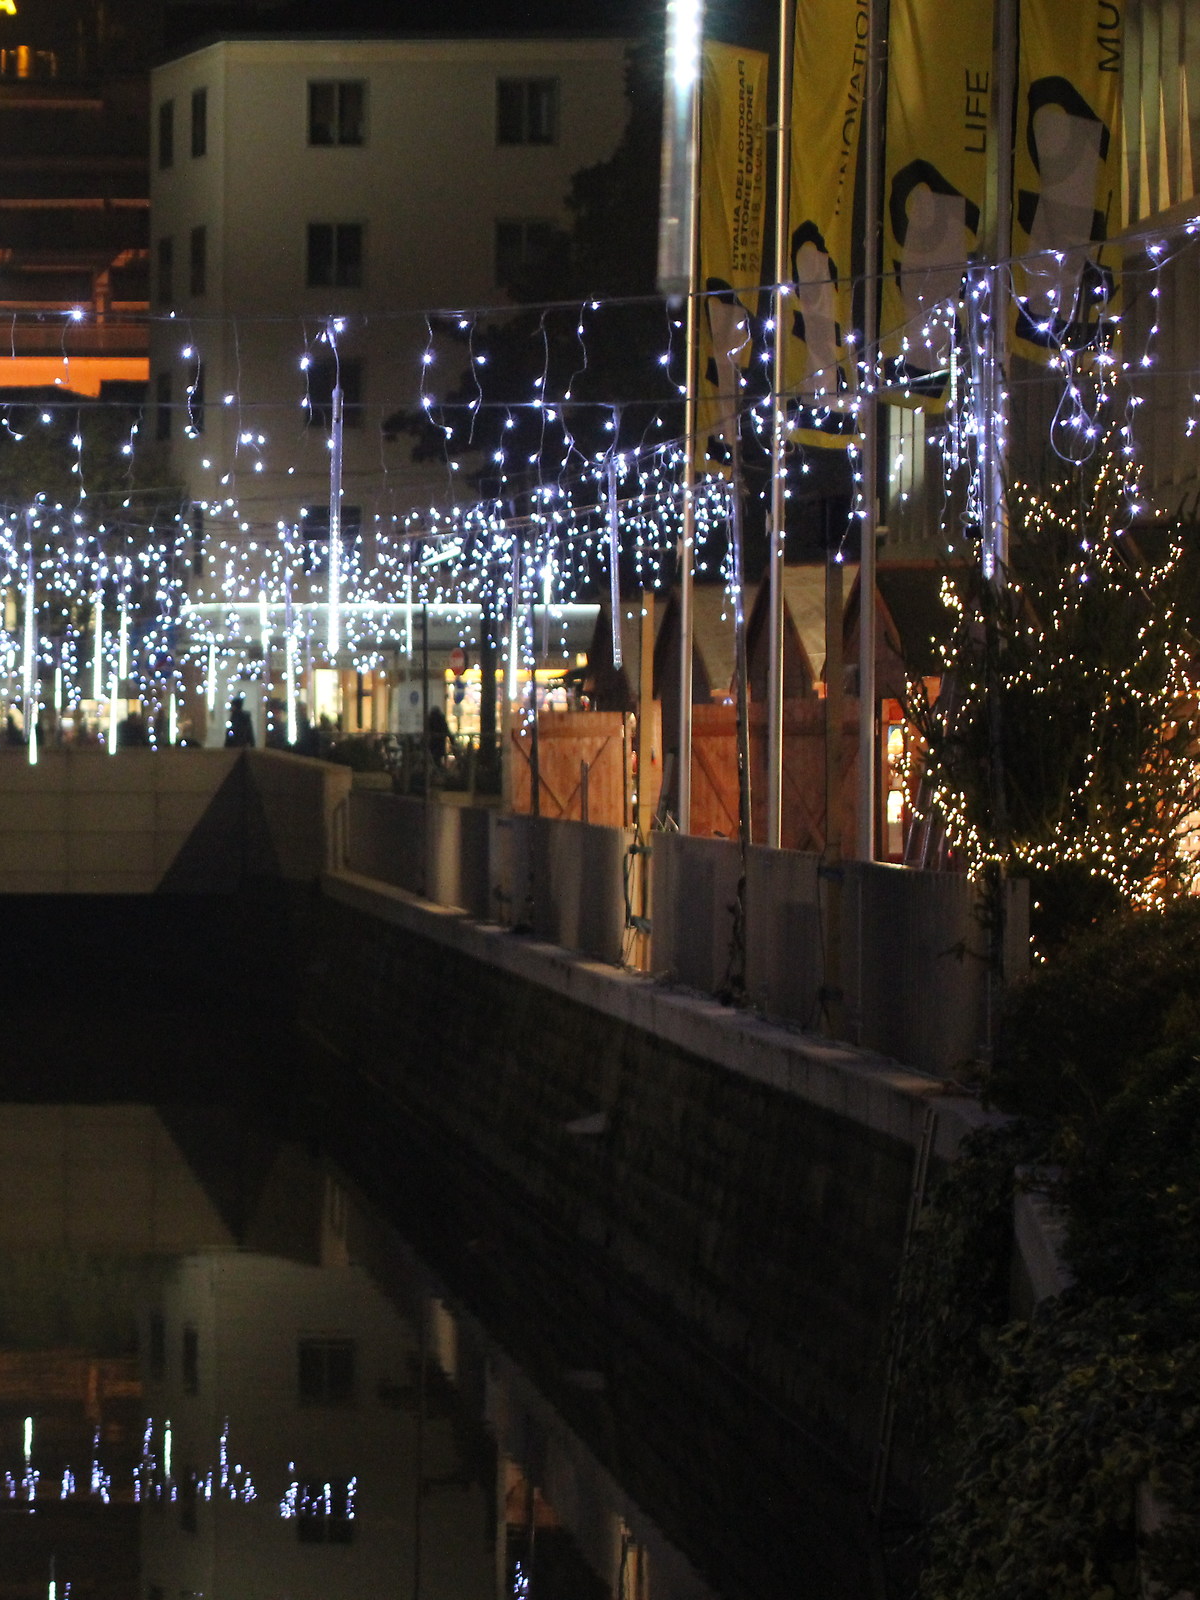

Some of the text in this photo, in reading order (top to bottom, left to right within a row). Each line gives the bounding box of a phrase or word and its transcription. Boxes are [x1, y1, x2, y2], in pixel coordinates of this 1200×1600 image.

[731, 59, 746, 271] L'ITALIA DEI FOTOGRAFI
[740, 84, 754, 273] 24 STORIE D'AUTORE
[964, 69, 989, 153] LIFE
